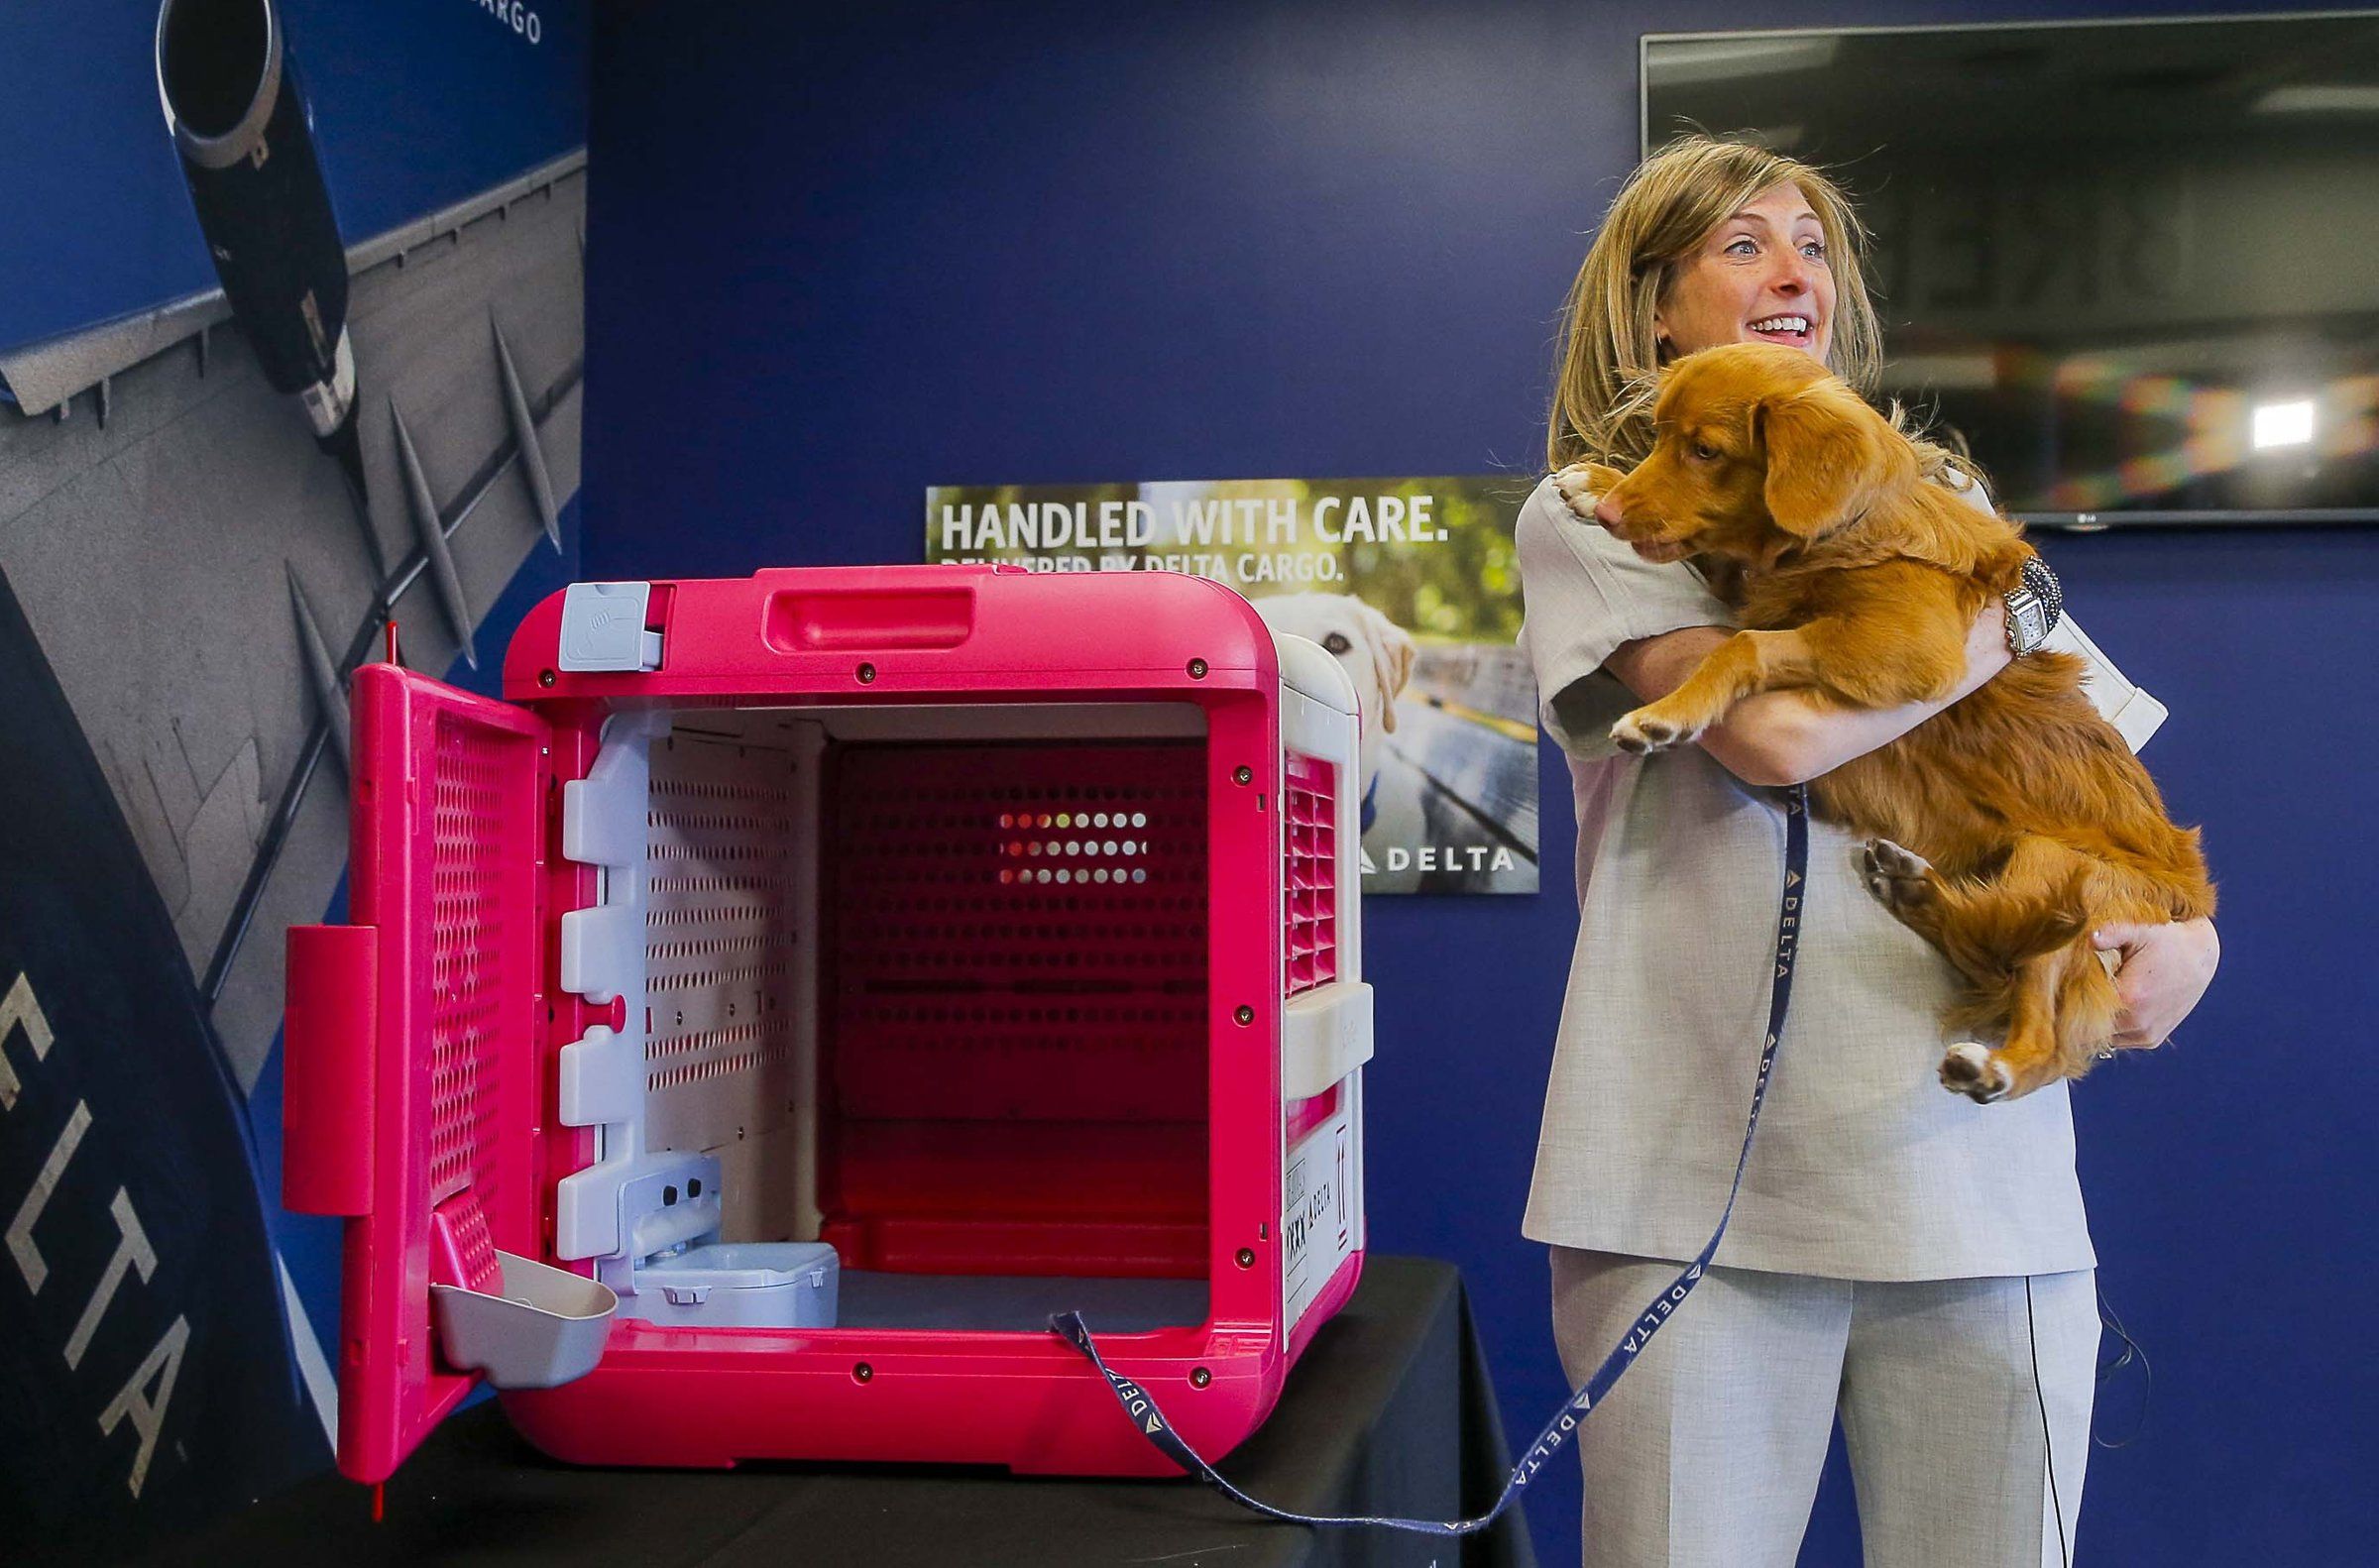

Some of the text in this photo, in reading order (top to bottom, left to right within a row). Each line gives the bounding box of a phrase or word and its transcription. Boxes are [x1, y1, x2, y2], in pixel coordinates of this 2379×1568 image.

[943, 496, 1448, 550] HANDLED WITH CARE.
[1236, 551, 1344, 583] CARGO.
[1387, 846, 1515, 871] DELTA
[1777, 897, 1798, 978] DELTA
[1624, 1285, 1686, 1354] DELTA
[1515, 1414, 1576, 1486] DELTA
